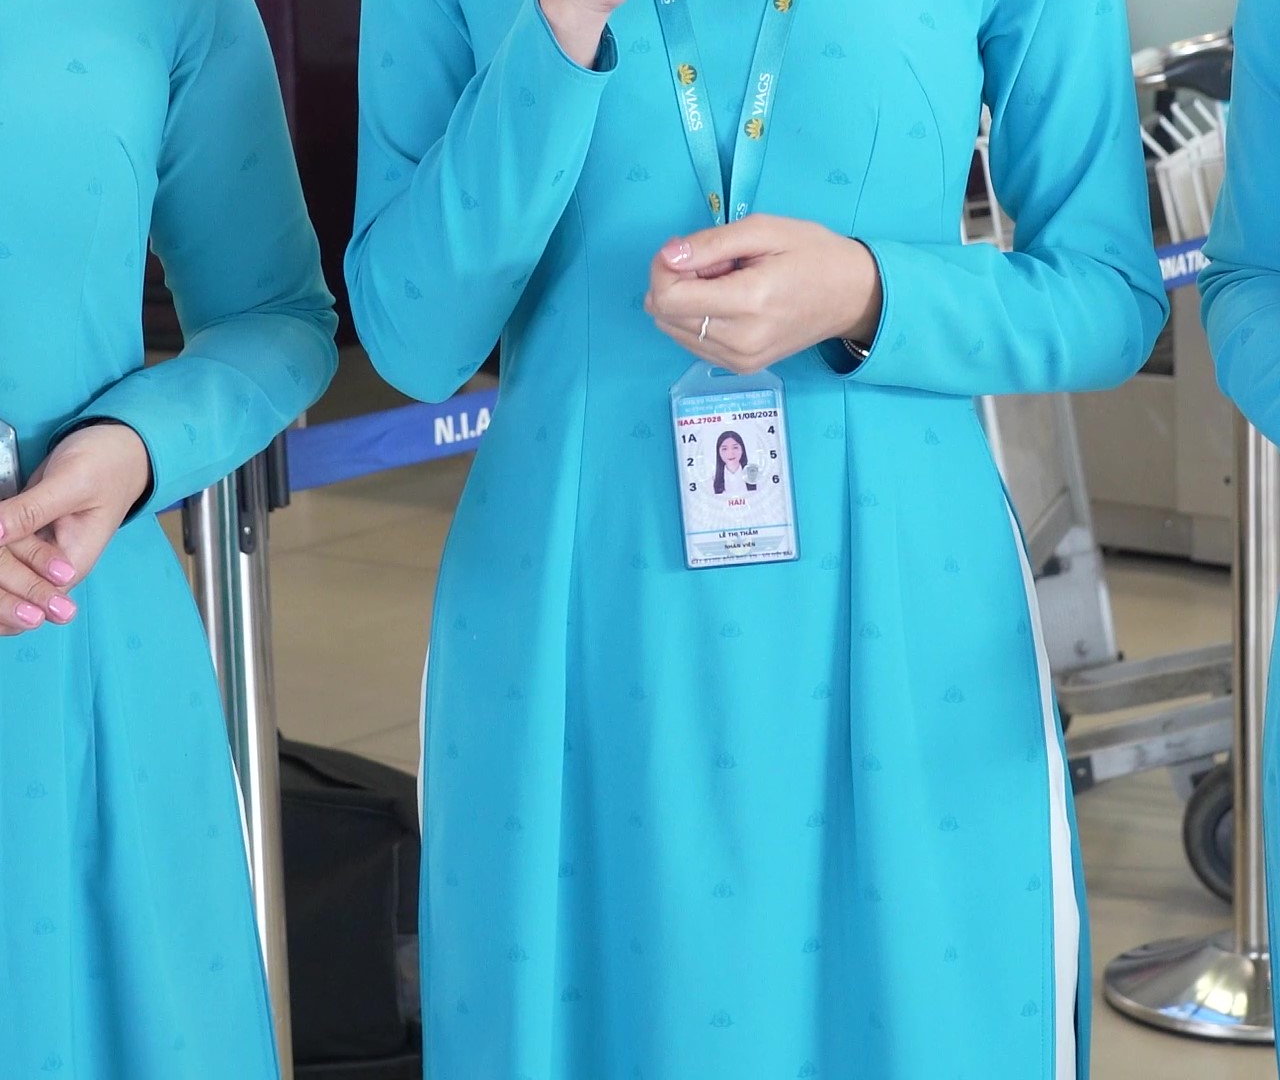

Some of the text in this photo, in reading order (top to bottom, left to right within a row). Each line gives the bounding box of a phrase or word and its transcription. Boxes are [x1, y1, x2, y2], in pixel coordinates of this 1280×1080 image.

[752, 73, 770, 116] VIAGS
[685, 87, 703, 131] VIAGS
[681, 426, 775, 444] 1A 4
[687, 450, 777, 467] 2 5
[689, 475, 780, 492] 3 6
